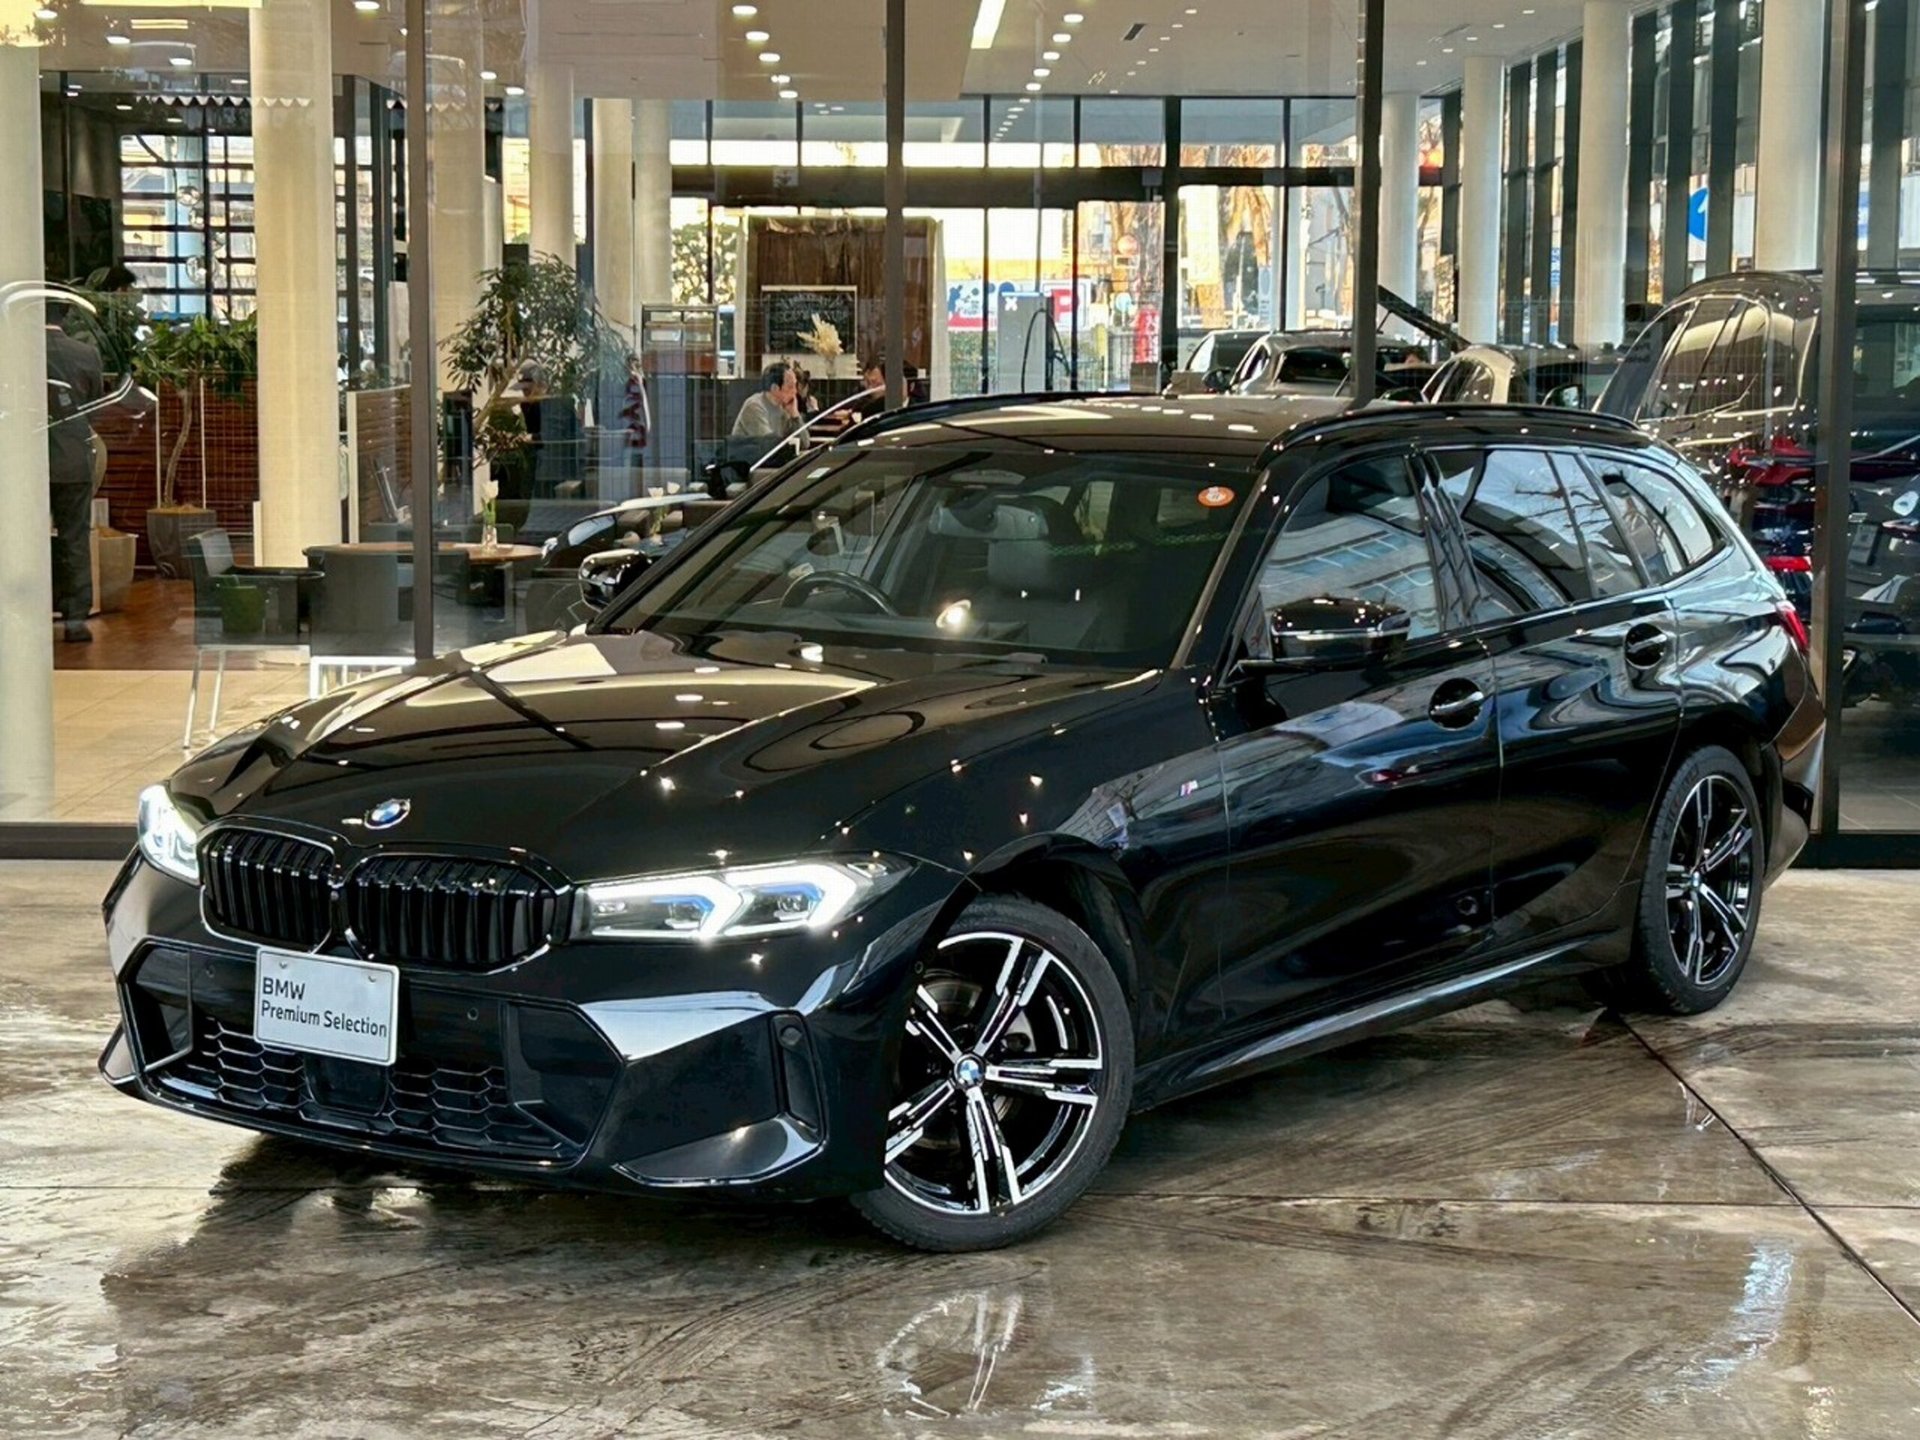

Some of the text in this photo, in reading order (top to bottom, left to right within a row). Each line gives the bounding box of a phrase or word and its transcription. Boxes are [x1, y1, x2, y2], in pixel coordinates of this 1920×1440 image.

[262, 977, 305, 1000] BMW
[261, 1000, 387, 1038] Premium Selection
